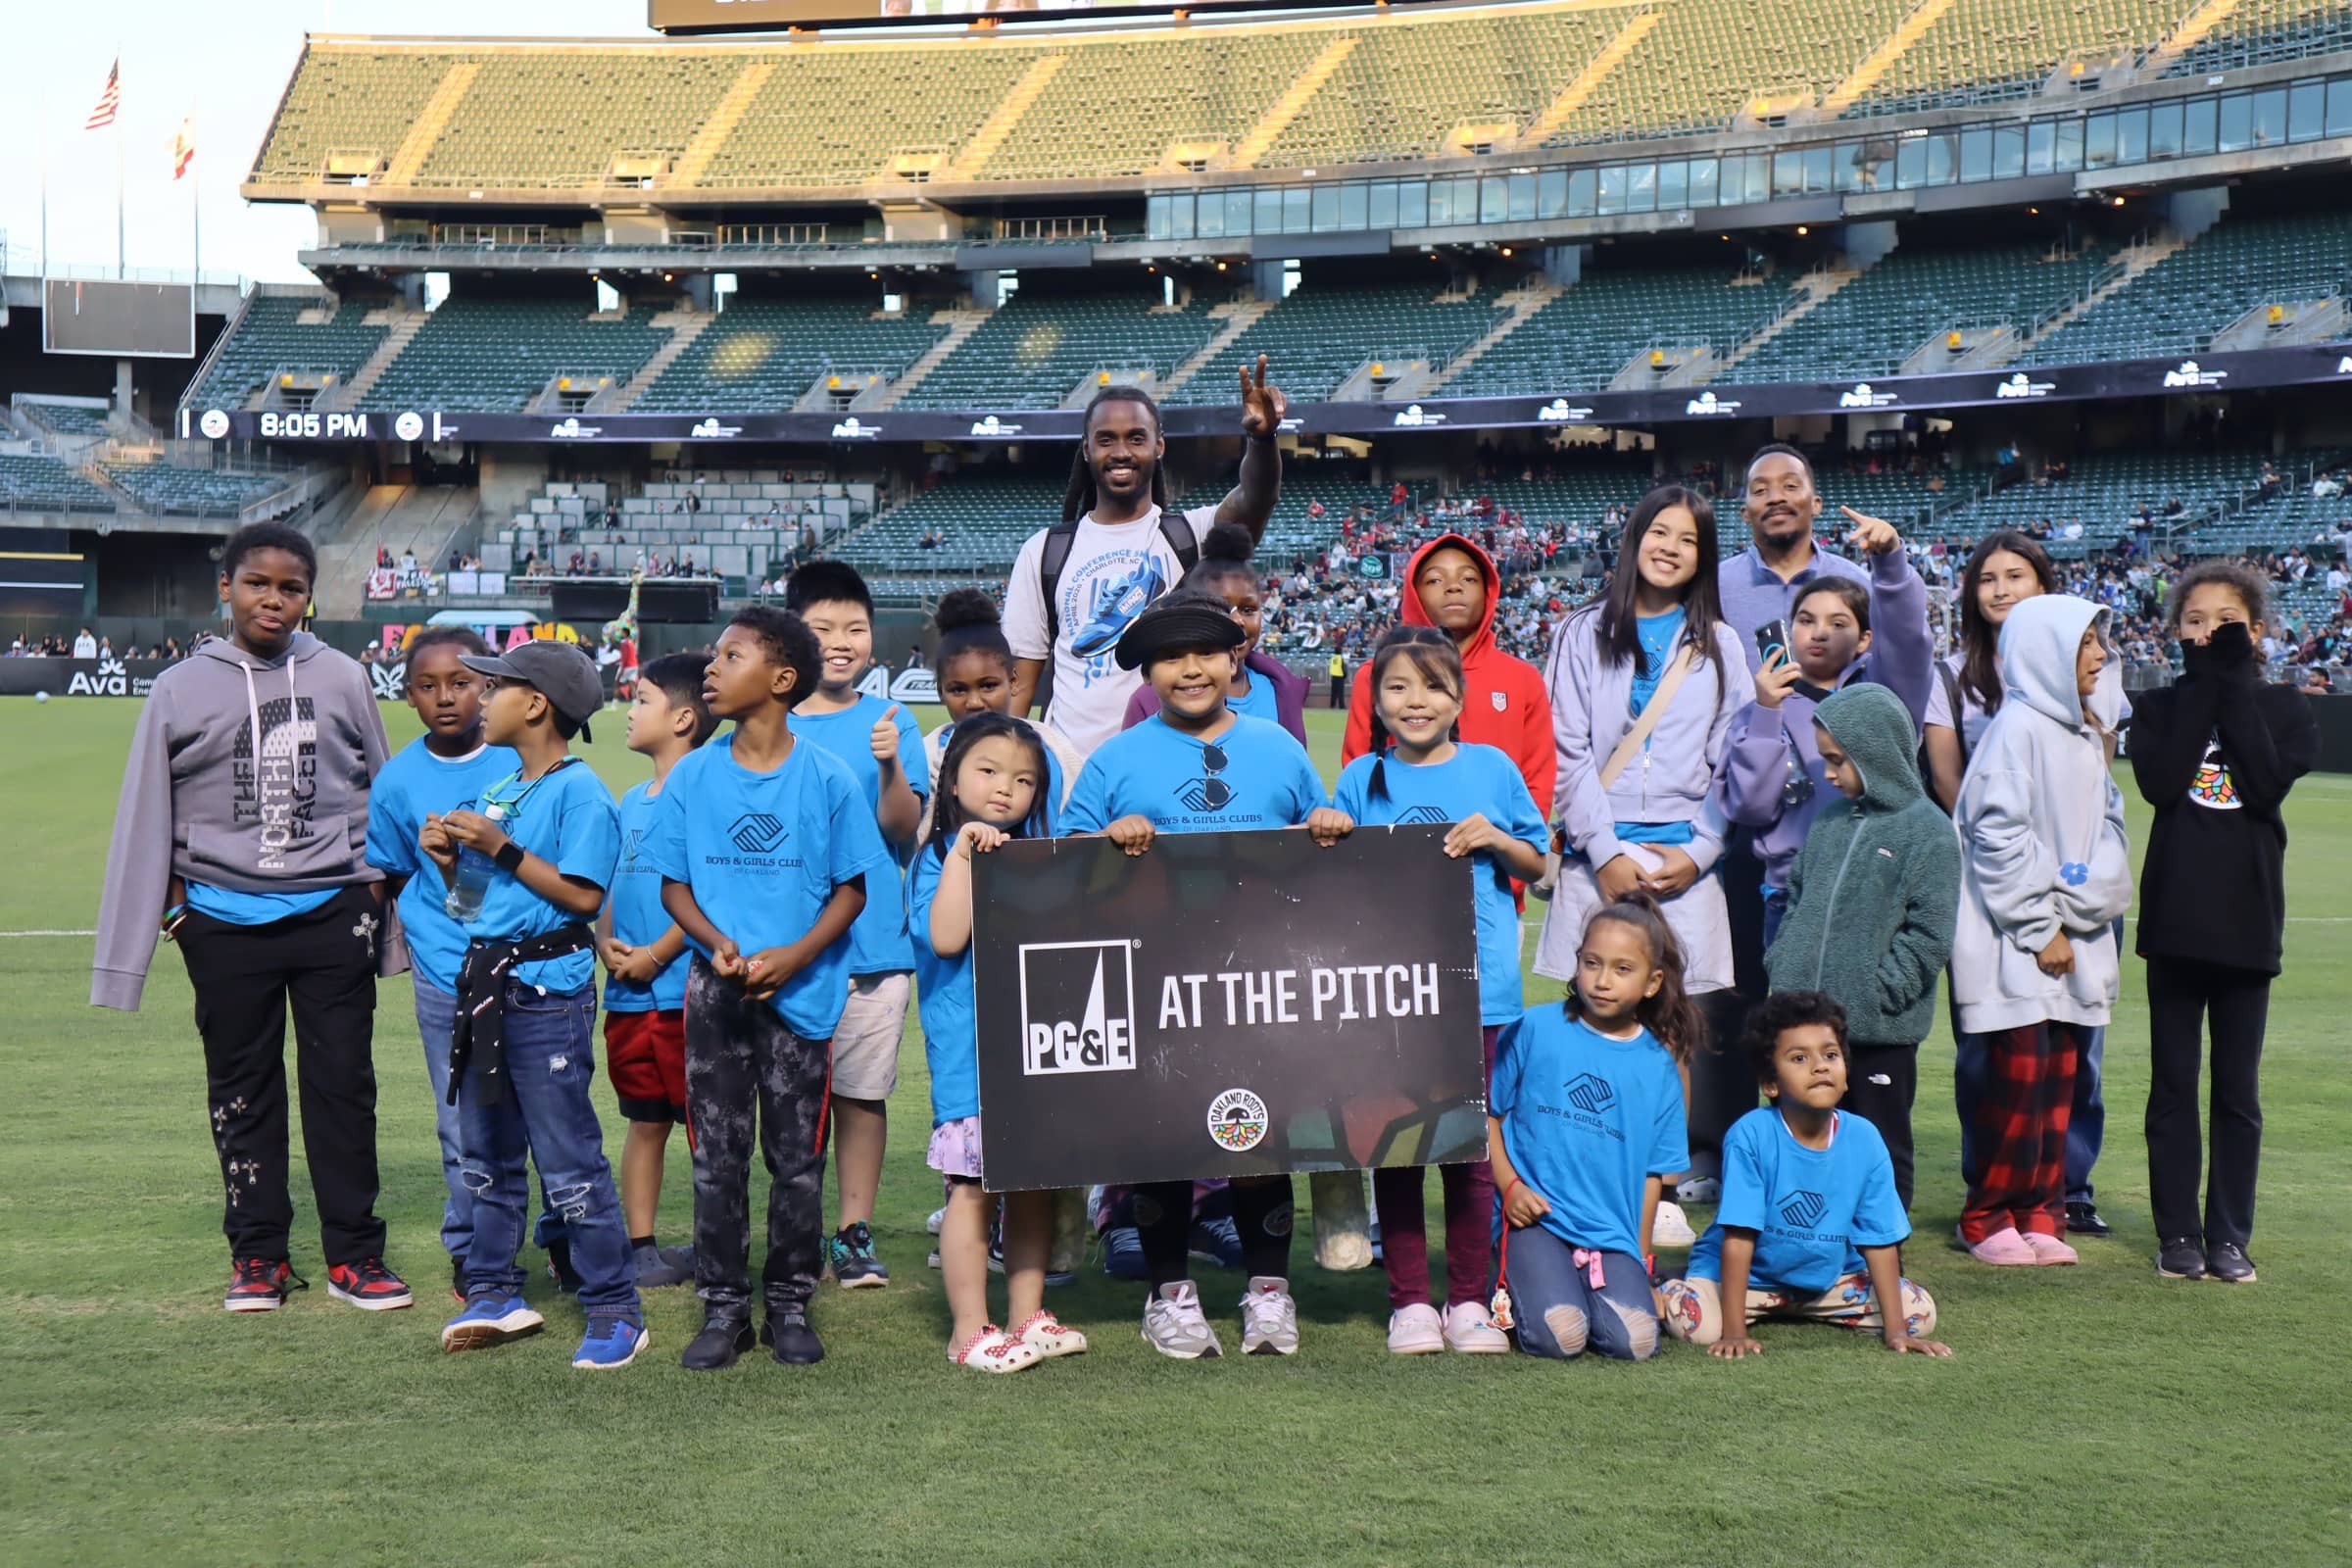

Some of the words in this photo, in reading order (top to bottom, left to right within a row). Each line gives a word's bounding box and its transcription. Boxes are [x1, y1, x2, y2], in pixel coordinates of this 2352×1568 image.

[260, 413, 319, 437] 8:05
[326, 413, 368, 437] PM
[1064, 586, 1076, 636] NATIONAL
[1072, 549, 1133, 583] CONFERENCE
[68, 671, 126, 696] Ava
[233, 761, 259, 822] THE
[291, 759, 317, 840] FACE
[258, 759, 291, 869] NORTH
[1152, 815, 1179, 825] BOYS
[1193, 815, 1226, 824] GIRLS
[1229, 814, 1262, 823] CLUBS
[706, 856, 731, 865] BOYS
[733, 857, 742, 865] &
[743, 857, 776, 867] GIRLS
[1158, 974, 1209, 1030] AT
[1217, 969, 1299, 1027] THE
[1311, 962, 1441, 1021] PITCH
[1029, 1018, 1130, 1070] PG&E
[1210, 1092, 1243, 1122] OAKLAND
[1243, 1093, 1265, 1120] ROOTS
[1537, 1104, 1562, 1116] BOYS
[1563, 1110, 1572, 1119] &
[1574, 1112, 1604, 1128] GIRLS
[1788, 1230, 1816, 1241] GIRLS
